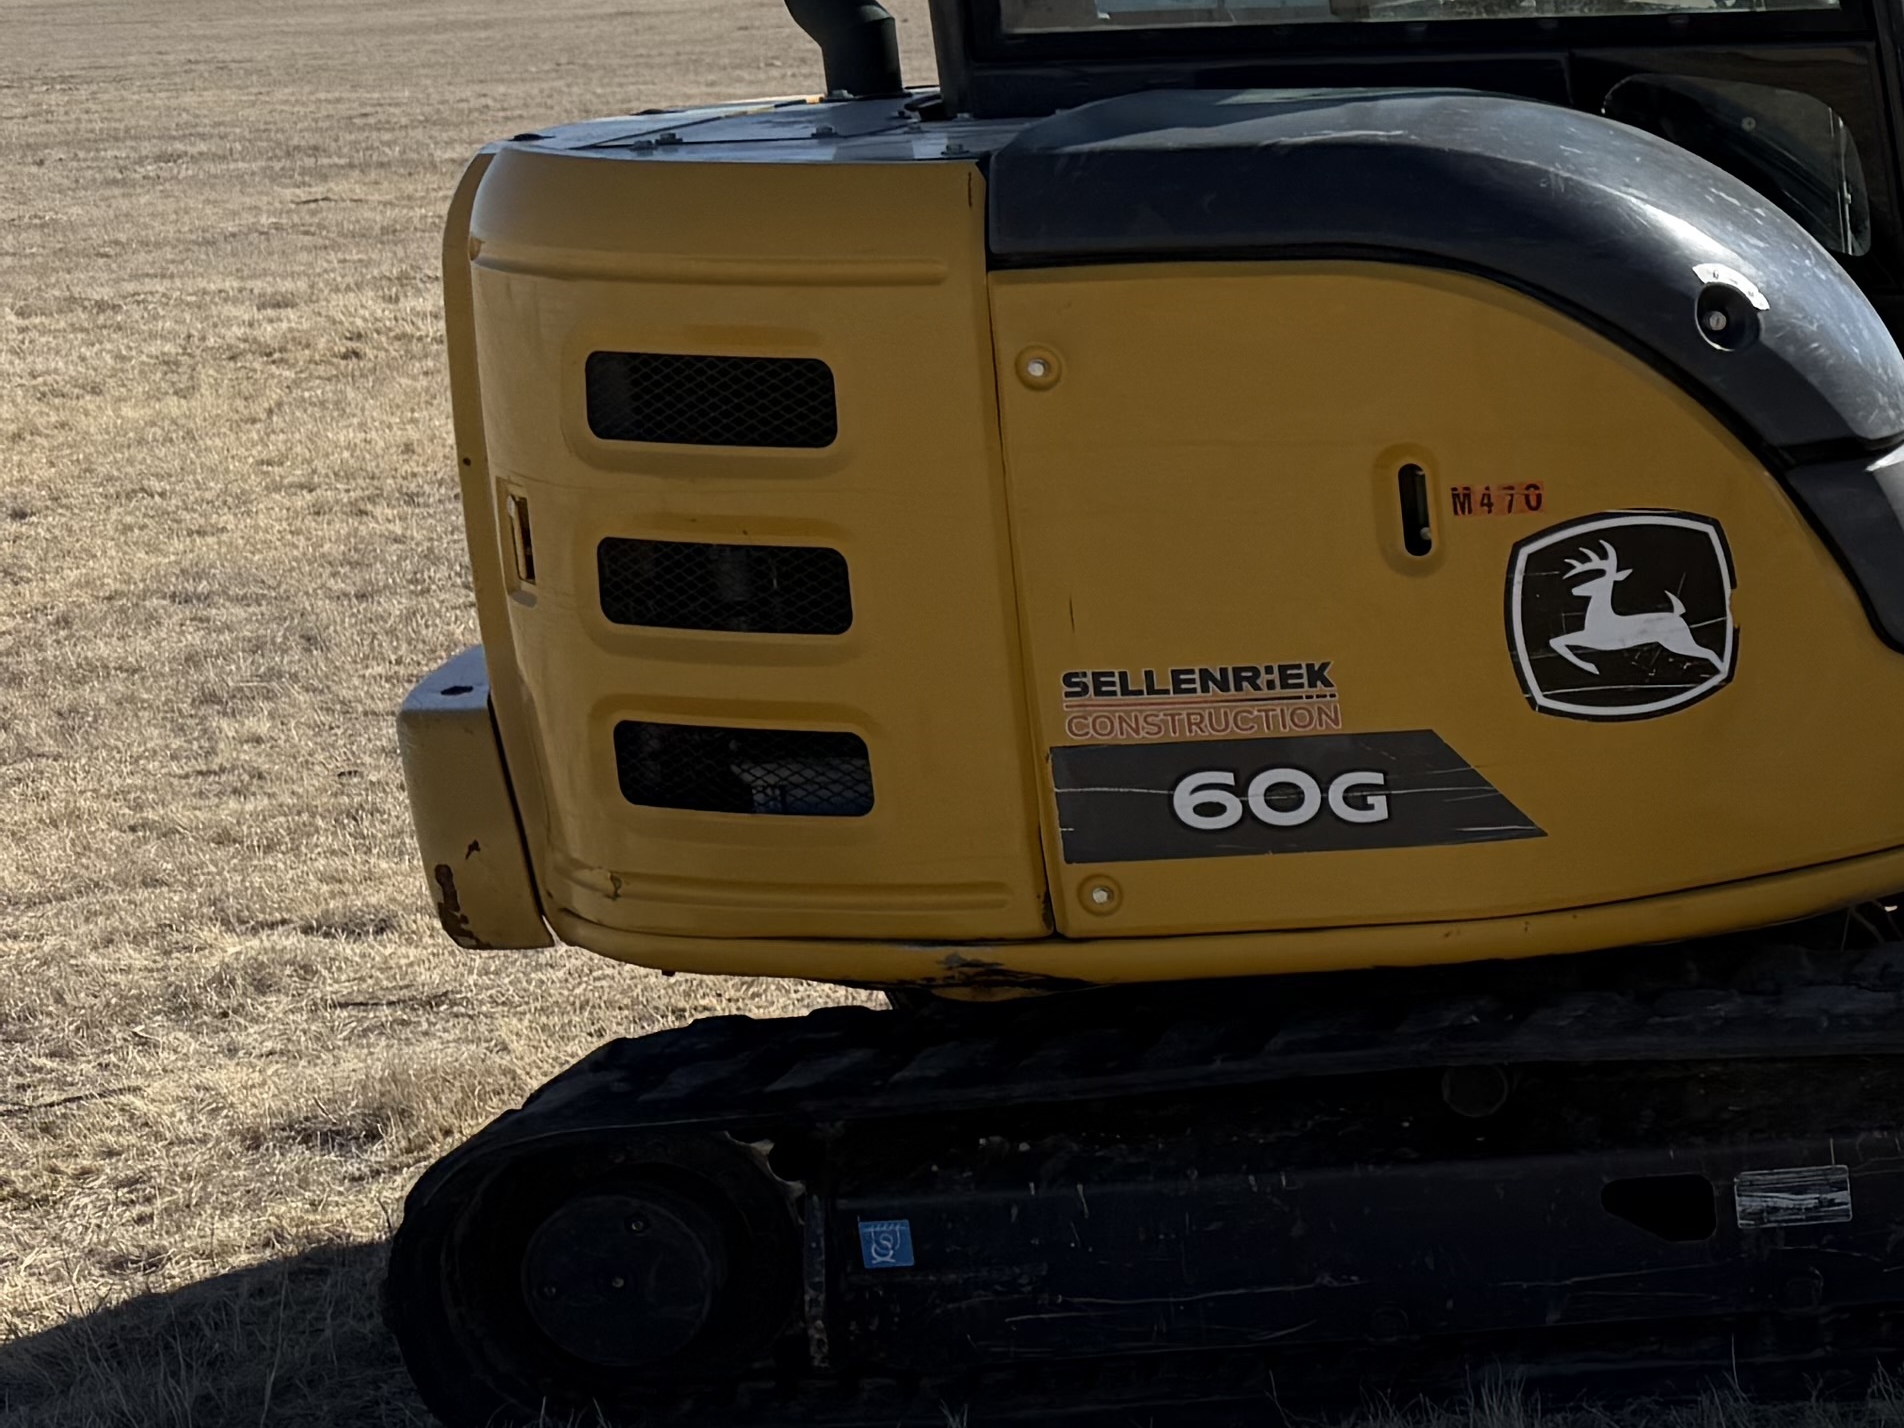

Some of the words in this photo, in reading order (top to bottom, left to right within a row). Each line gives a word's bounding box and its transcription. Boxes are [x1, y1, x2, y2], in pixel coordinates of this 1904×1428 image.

[1451, 483, 1542, 516] M470
[1066, 702, 1342, 739] CONSTRUCTION
[1172, 768, 1390, 831] 60G
